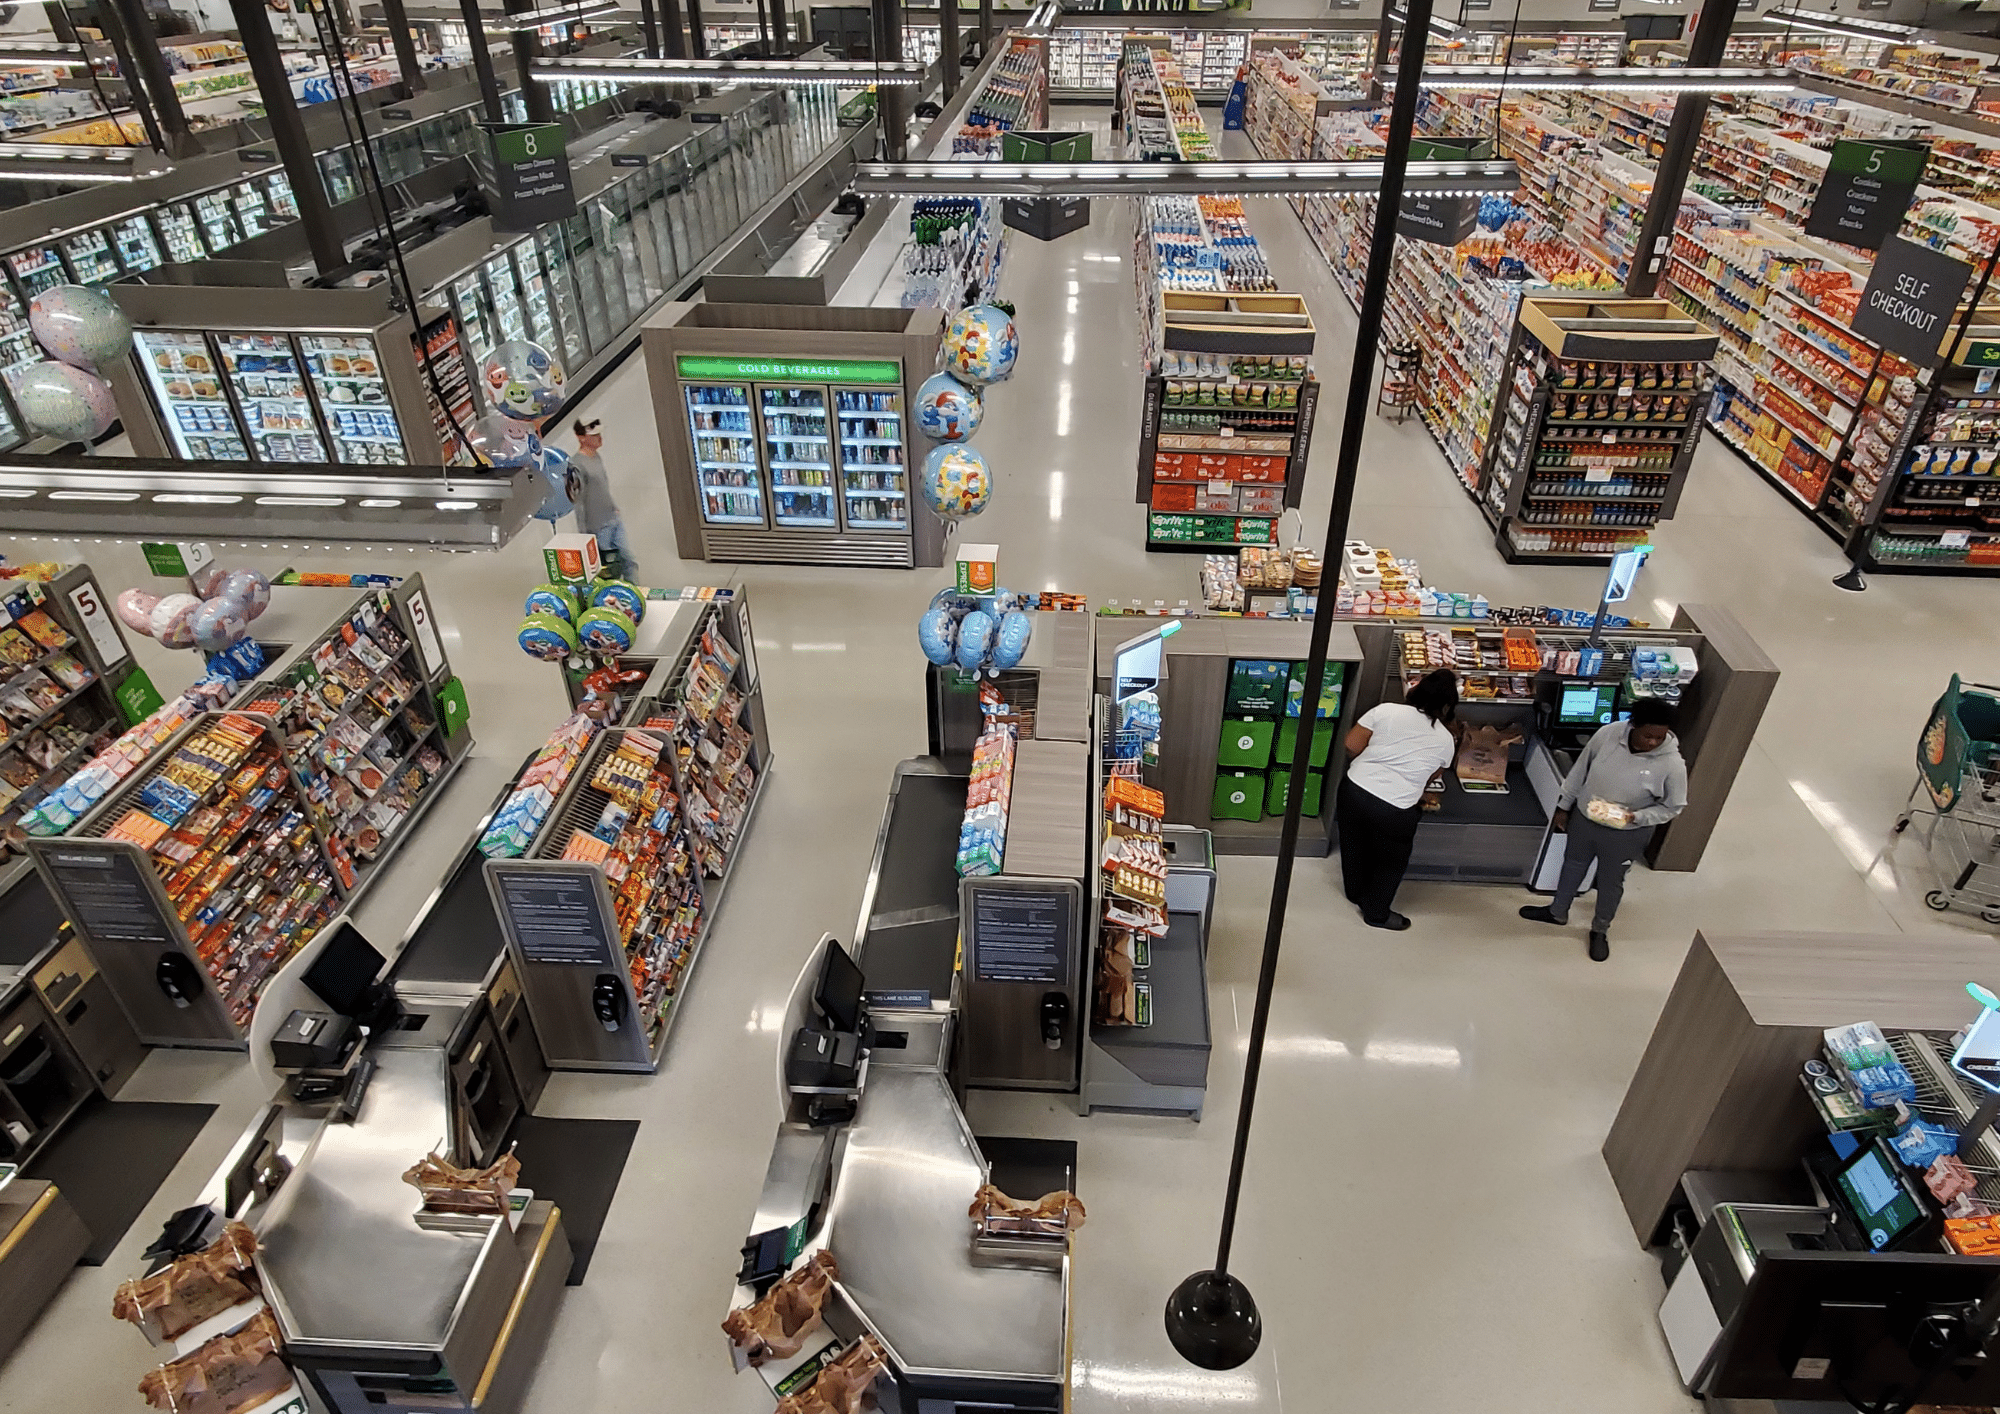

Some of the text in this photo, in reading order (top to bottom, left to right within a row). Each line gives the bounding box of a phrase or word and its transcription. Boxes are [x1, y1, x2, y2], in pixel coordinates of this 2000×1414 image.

[525, 133, 537, 155] 8
[1020, 141, 1027, 160] 7
[1069, 141, 1076, 160] 7
[513, 162, 534, 171] Frozen
[1865, 150, 1885, 173] 5
[519, 171, 554, 184] Frozen Meat
[1852, 176, 1882, 189] Cookies
[514, 183, 565, 199] Frozen Vegetables
[1846, 189, 1878, 202] Crackers
[1847, 204, 1866, 216] Nuts
[1426, 217, 1444, 229] Drinks
[1838, 217, 1863, 230] Snacks
[1894, 273, 1930, 300] SELF
[1870, 289, 1938, 333] CHECKOUT
[737, 364, 841, 376] COLD BEVERAGES
[1145, 392, 1155, 439] GUARANTEED
[1297, 397, 1314, 463] CARRYOUT SERVICE
[1517, 403, 1540, 473] CHECKOUT PROMISE
[1683, 406, 1705, 454] GUARANTEED
[1152, 515, 1185, 527] Sprite
[190, 543, 202, 562] 5
[547, 550, 560, 581] EXPRESS
[960, 562, 968, 593] EXPRESS
[77, 590, 97, 616] 5
[412, 599, 424, 625] 5
[741, 611, 748, 637] 5
